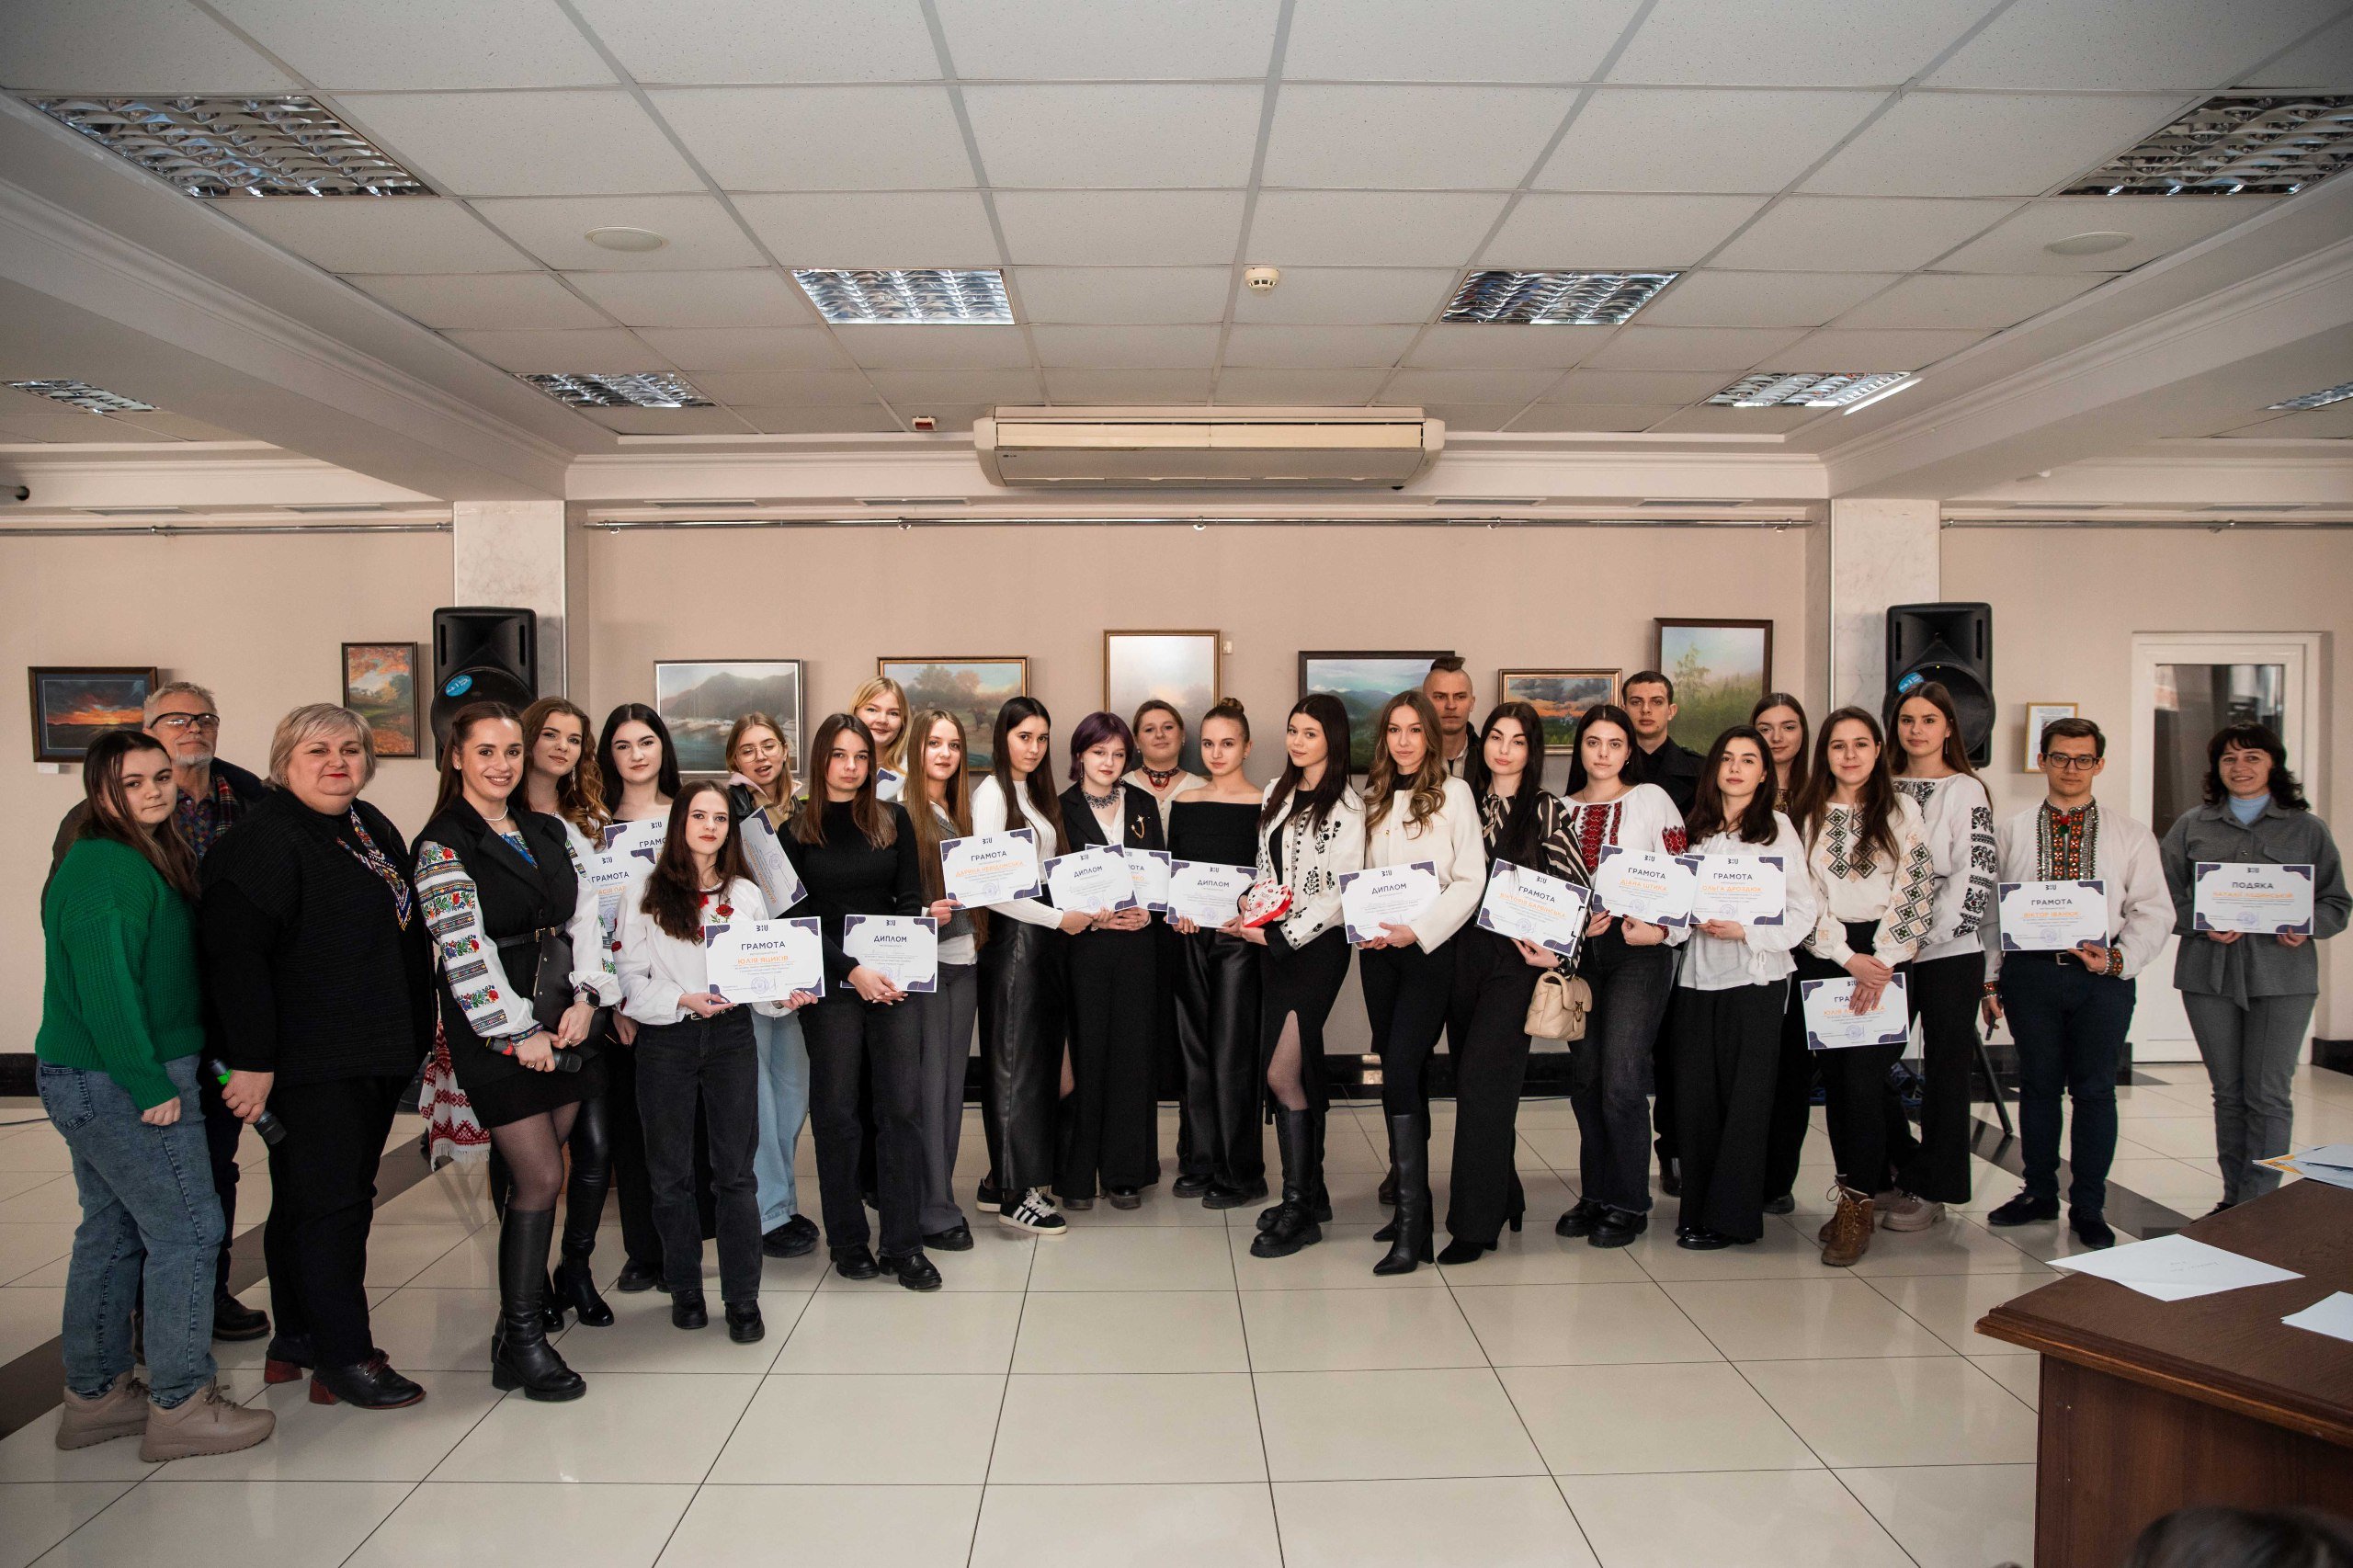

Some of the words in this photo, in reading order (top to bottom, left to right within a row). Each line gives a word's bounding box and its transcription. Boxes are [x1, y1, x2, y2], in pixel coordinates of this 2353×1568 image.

[639, 837, 666, 848] ГРАМО
[971, 850, 1007, 862] ГРАМОТА
[591, 871, 630, 883] ГРАМОТА
[1074, 865, 1103, 879] ДИПЛОМ
[1628, 867, 1666, 880] ГРАМОТА
[1713, 872, 1753, 881] ГРАМОТА
[1197, 879, 1230, 888] ДИПЛОМ
[1371, 882, 1407, 895] ДИПЛОМ
[2232, 881, 2274, 890] ПОДЯКА
[1518, 885, 1555, 903] ГРАМОТА
[2031, 898, 2073, 906] ГРАМОТА
[873, 935, 907, 943] ДИПЛОМ
[741, 940, 786, 951] ГРАМОТА
